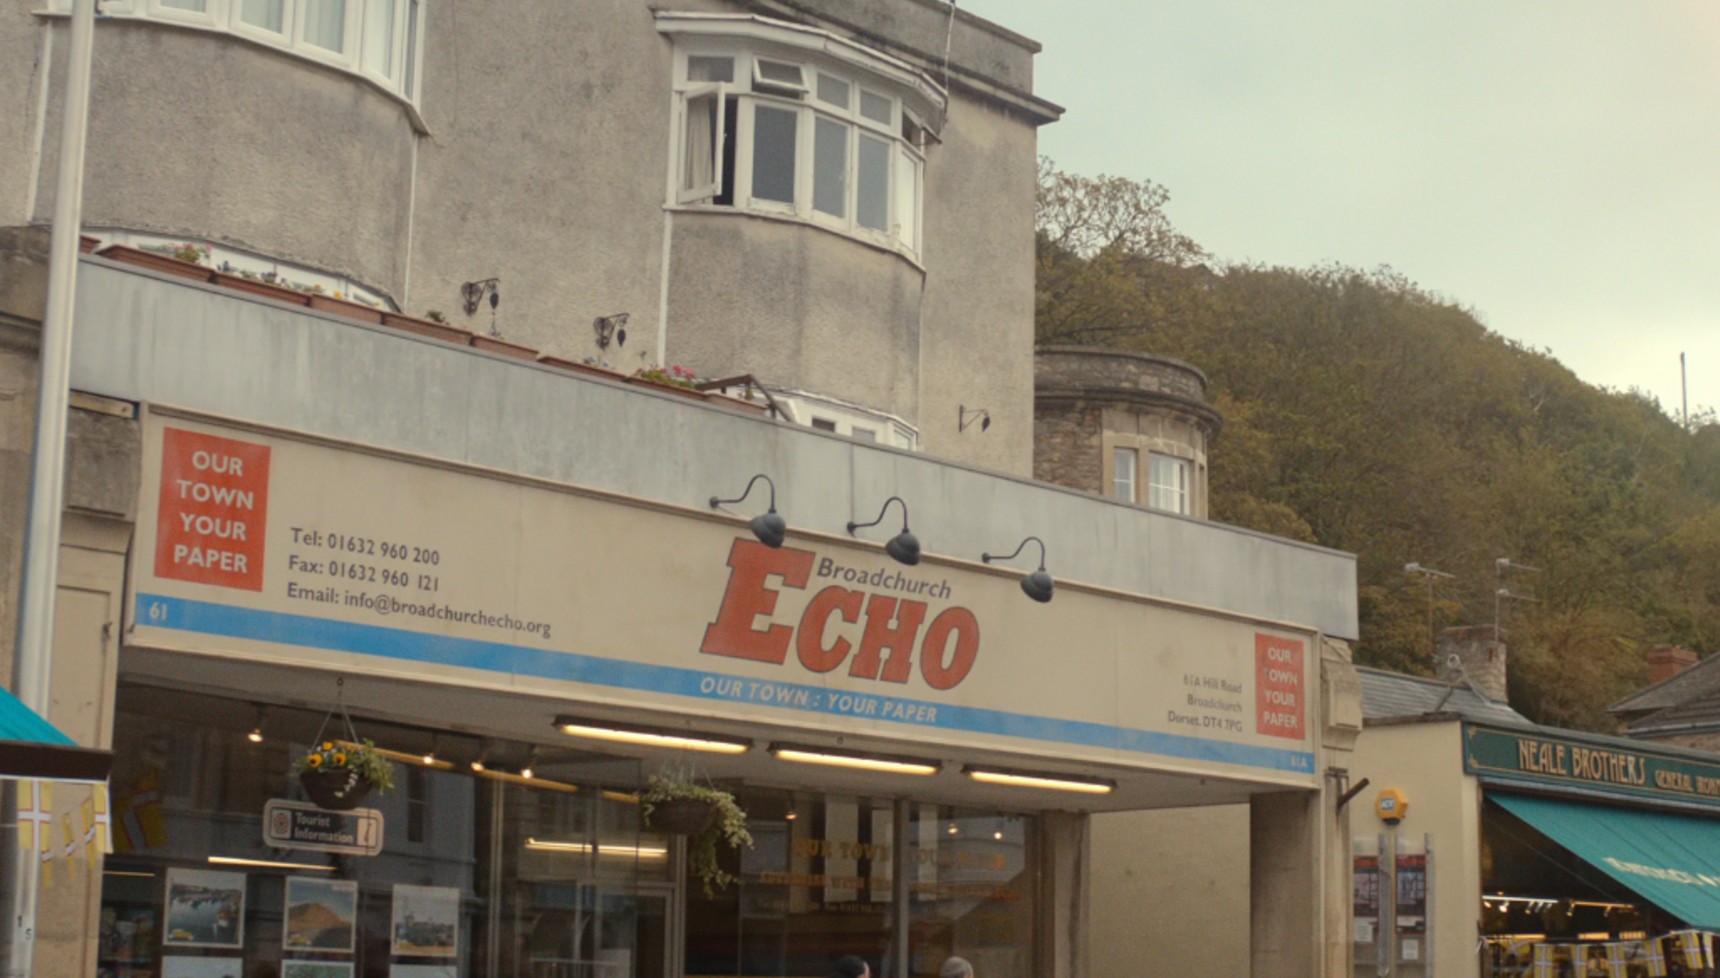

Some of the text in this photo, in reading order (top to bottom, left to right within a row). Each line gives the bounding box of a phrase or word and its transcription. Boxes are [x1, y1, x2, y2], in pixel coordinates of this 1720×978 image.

[192, 451, 244, 477] OUR
[176, 479, 254, 510] TOWN
[180, 512, 246, 541] YOUR
[174, 545, 248, 573] PAPER
[291, 527, 440, 566] Tel: 01632 960 200
[288, 554, 439, 592] Fax: 01632 960 121
[817, 556, 952, 600] Broadchurch
[149, 602, 168, 621] 61
[287, 581, 552, 640] Email: info@broadchurchecho.org
[699, 537, 981, 691] ECHO
[1268, 647, 1292, 663] OUR
[1203, 676, 1219, 690] Hill
[1220, 679, 1242, 694] Road
[1264, 667, 1298, 685] TOWN
[700, 675, 743, 698] OUR
[749, 682, 809, 707] TOWN
[827, 692, 877, 716] YOUR
[881, 702, 938, 723] PAPER
[1187, 693, 1242, 713] Broadchurch
[1265, 690, 1296, 707] YOUR
[1203, 717, 1223, 730] DT4
[1224, 719, 1243, 733] 7PG
[1263, 710, 1298, 728] PAPER
[1518, 739, 1567, 776] NEALE
[1571, 746, 1646, 785] BROTHERS
[295, 811, 331, 828] Tourist
[294, 827, 354, 844] Information
